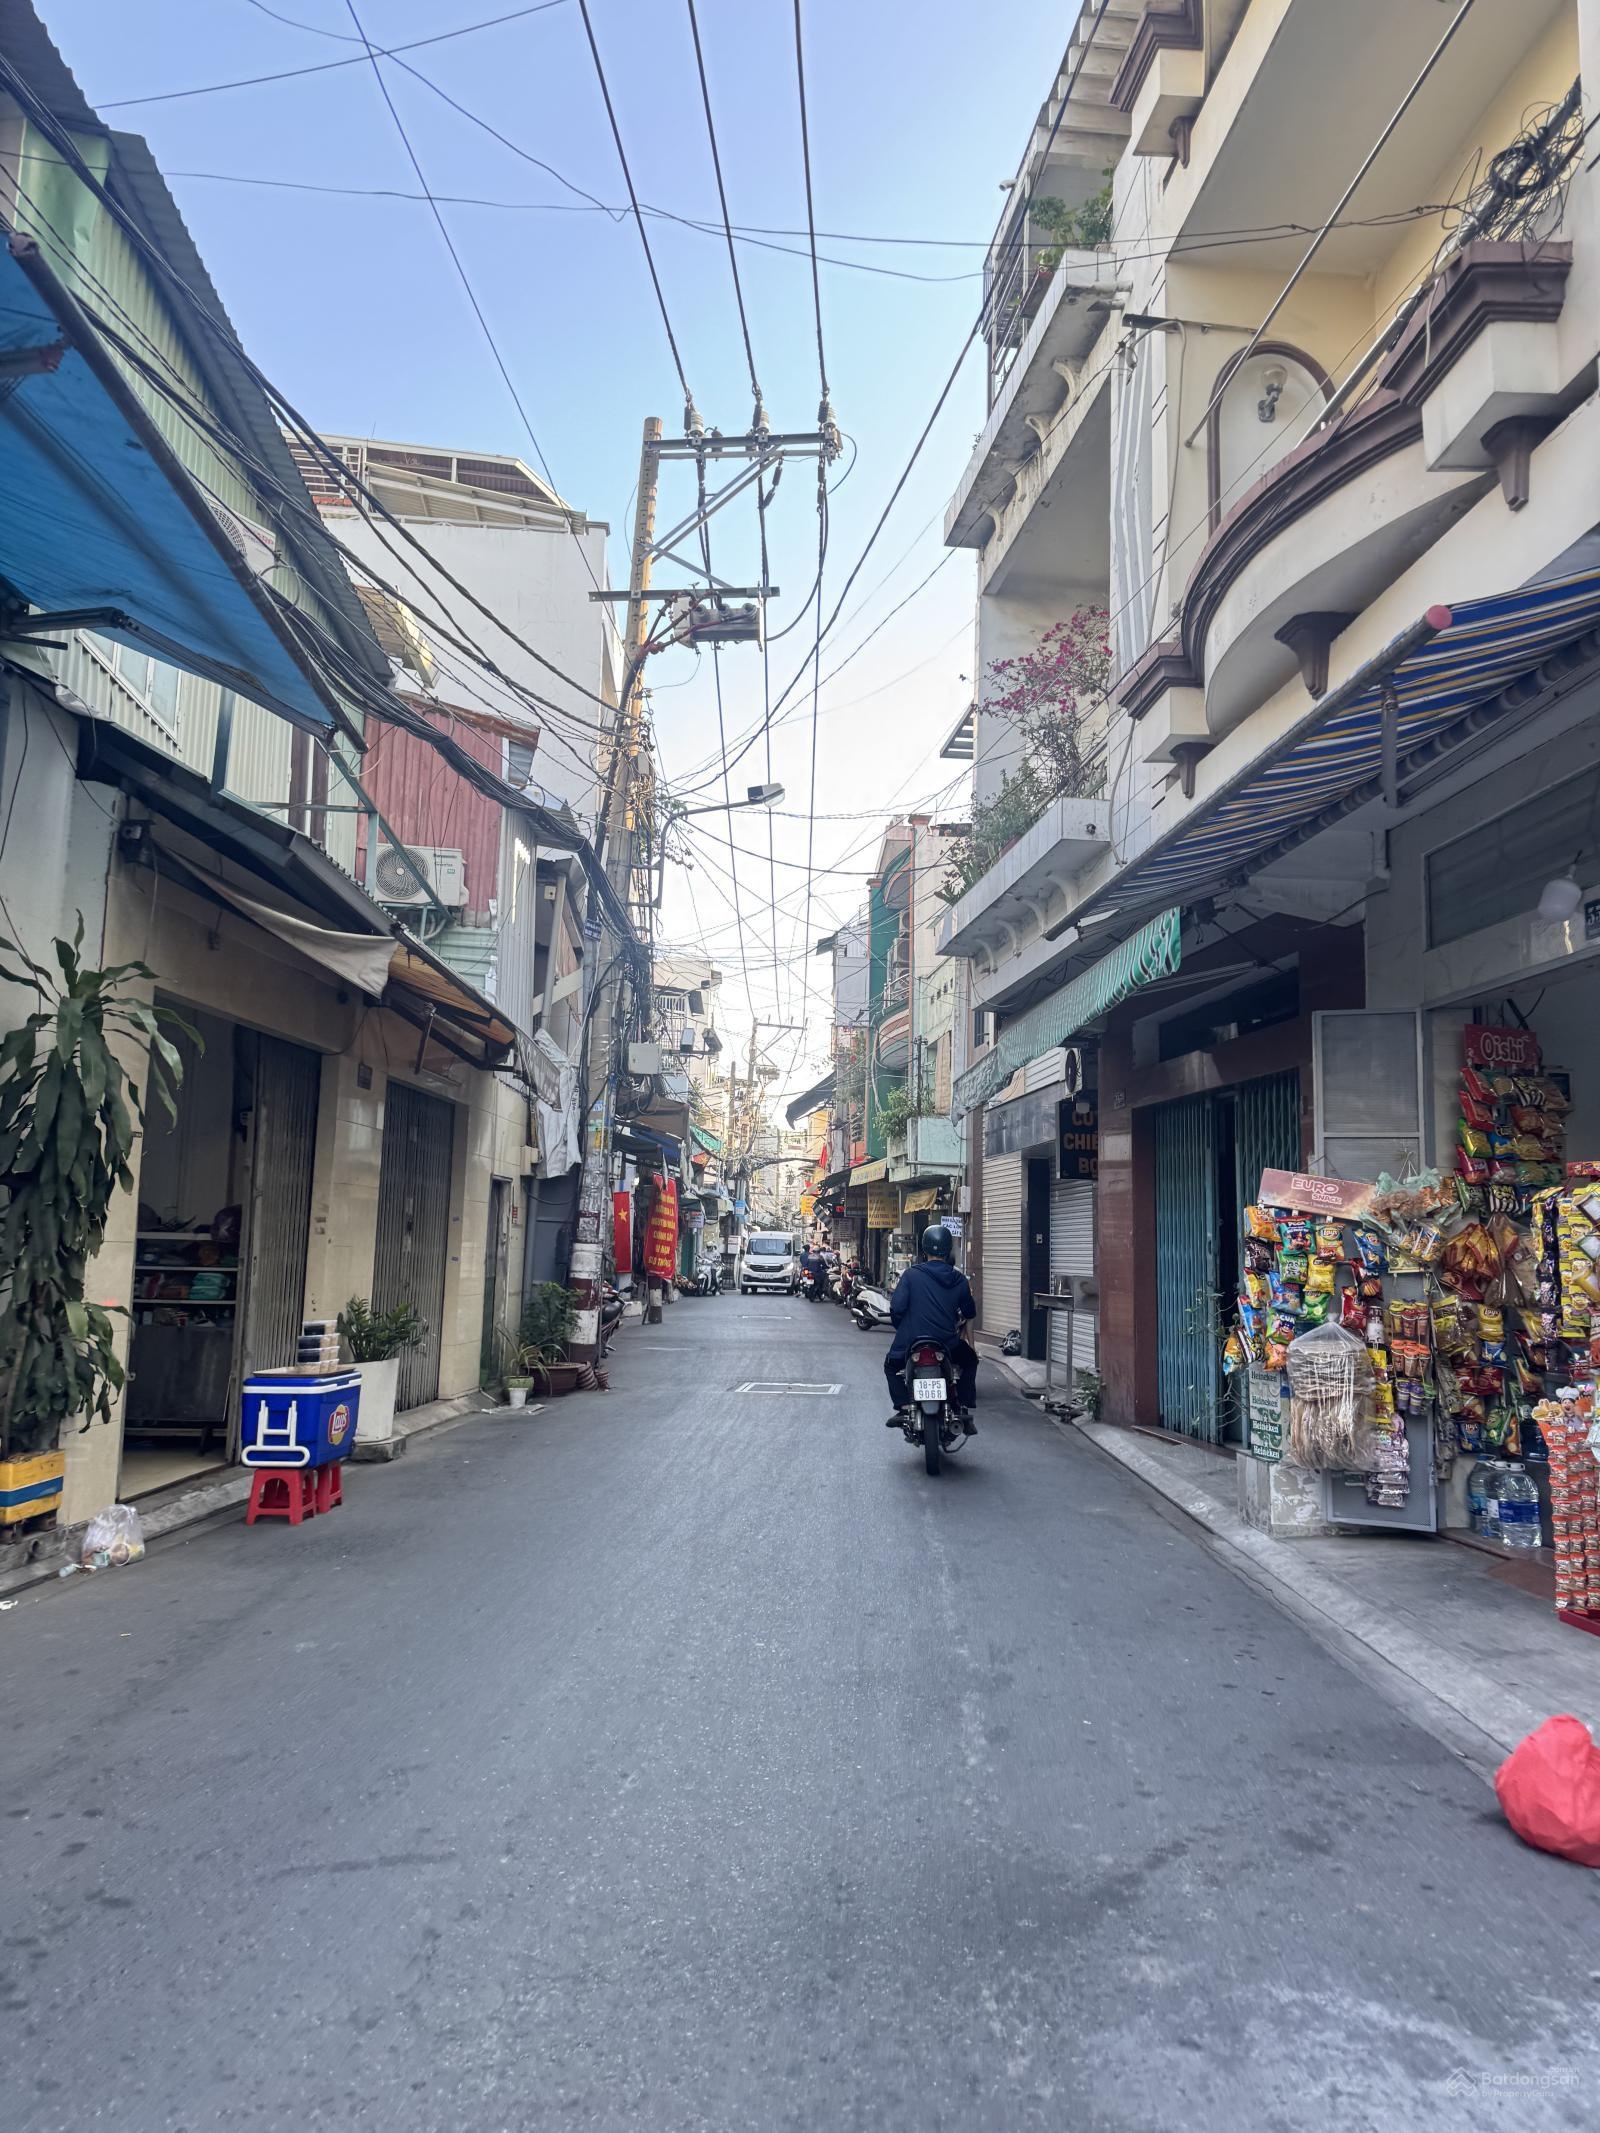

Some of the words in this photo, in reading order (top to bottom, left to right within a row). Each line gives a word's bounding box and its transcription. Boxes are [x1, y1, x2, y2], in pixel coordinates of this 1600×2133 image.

[1481, 1032, 1525, 1063] Oishi
[1291, 1178, 1339, 1195] EURO
[1311, 1193, 1342, 1205] SNACK
[1251, 1370, 1278, 1382] Heineken
[1252, 1395, 1279, 1408] Heineken
[1252, 1420, 1279, 1433] Heineken
[1253, 1445, 1280, 1459] Heineken
